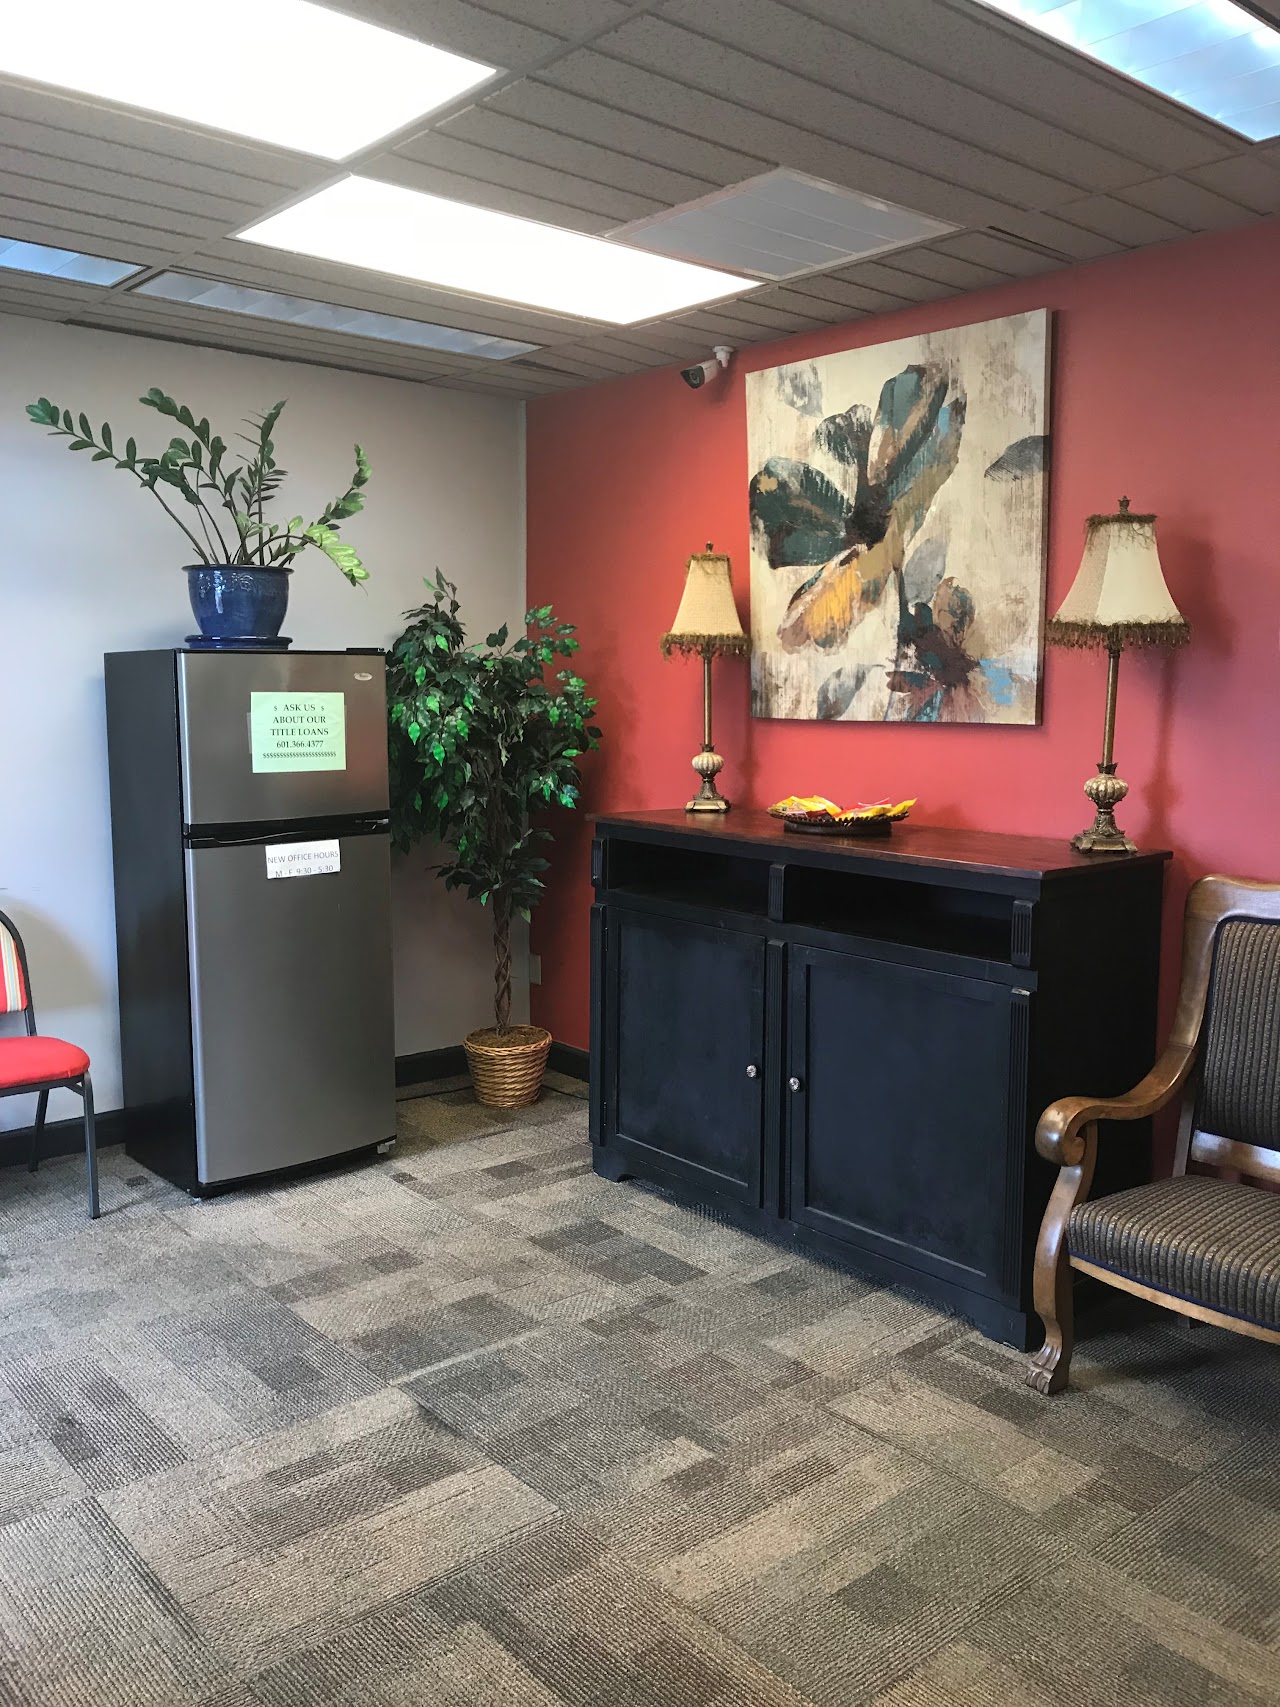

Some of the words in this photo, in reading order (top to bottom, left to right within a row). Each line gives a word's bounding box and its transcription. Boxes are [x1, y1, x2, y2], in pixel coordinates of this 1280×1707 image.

[273, 716, 305, 724] ABOUT
[306, 716, 326, 724] OUR
[270, 728, 297, 736] TITLE
[298, 728, 329, 736] LOANS
[276, 740, 324, 748] 601.366.4377
[268, 856, 286, 864] NEW
